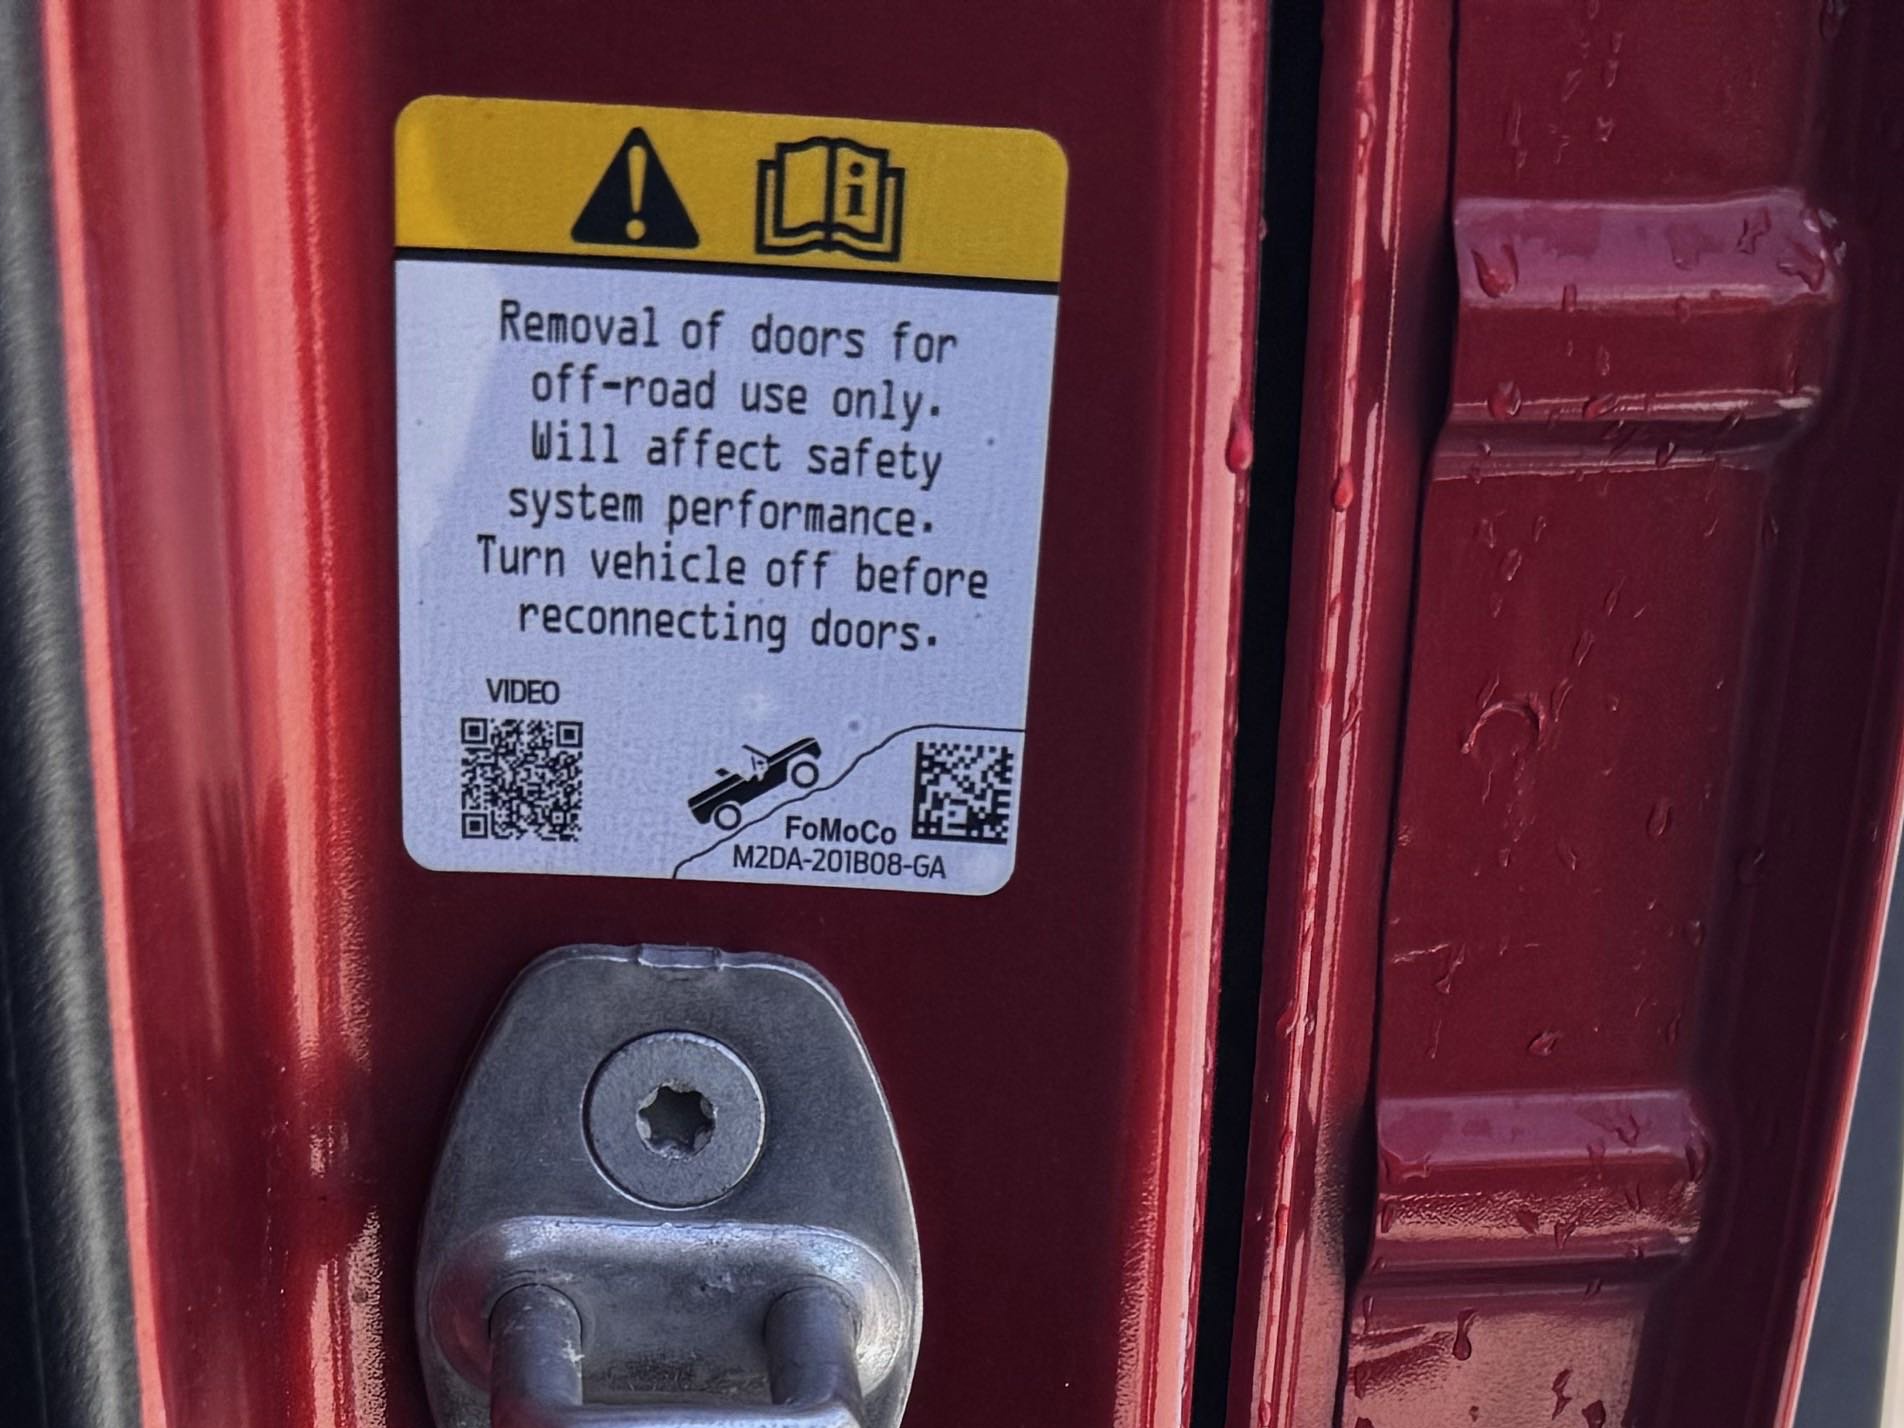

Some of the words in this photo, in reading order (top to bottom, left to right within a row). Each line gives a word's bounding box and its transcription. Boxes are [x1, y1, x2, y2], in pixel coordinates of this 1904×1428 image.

[499, 299, 658, 349] Removal
[682, 311, 722, 350] of
[751, 315, 865, 359] doors
[894, 321, 958, 364] for
[531, 366, 716, 411] off-road
[741, 382, 807, 416] use
[832, 381, 942, 432] only.
[531, 421, 620, 465] Will
[647, 429, 783, 472] affect
[807, 438, 942, 491] safety
[508, 485, 643, 530] system
[667, 489, 935, 538] performance.
[477, 534, 565, 577] Turn
[590, 542, 746, 586] vehicle
[765, 550, 828, 592] off
[856, 558, 989, 600] before
[519, 598, 787, 653] reconnecting
[810, 613, 939, 652] doors.
[485, 678, 561, 704] VIDEO
[784, 816, 899, 846] FoMoCo
[732, 844, 947, 879] M2DA-201B08-GA
